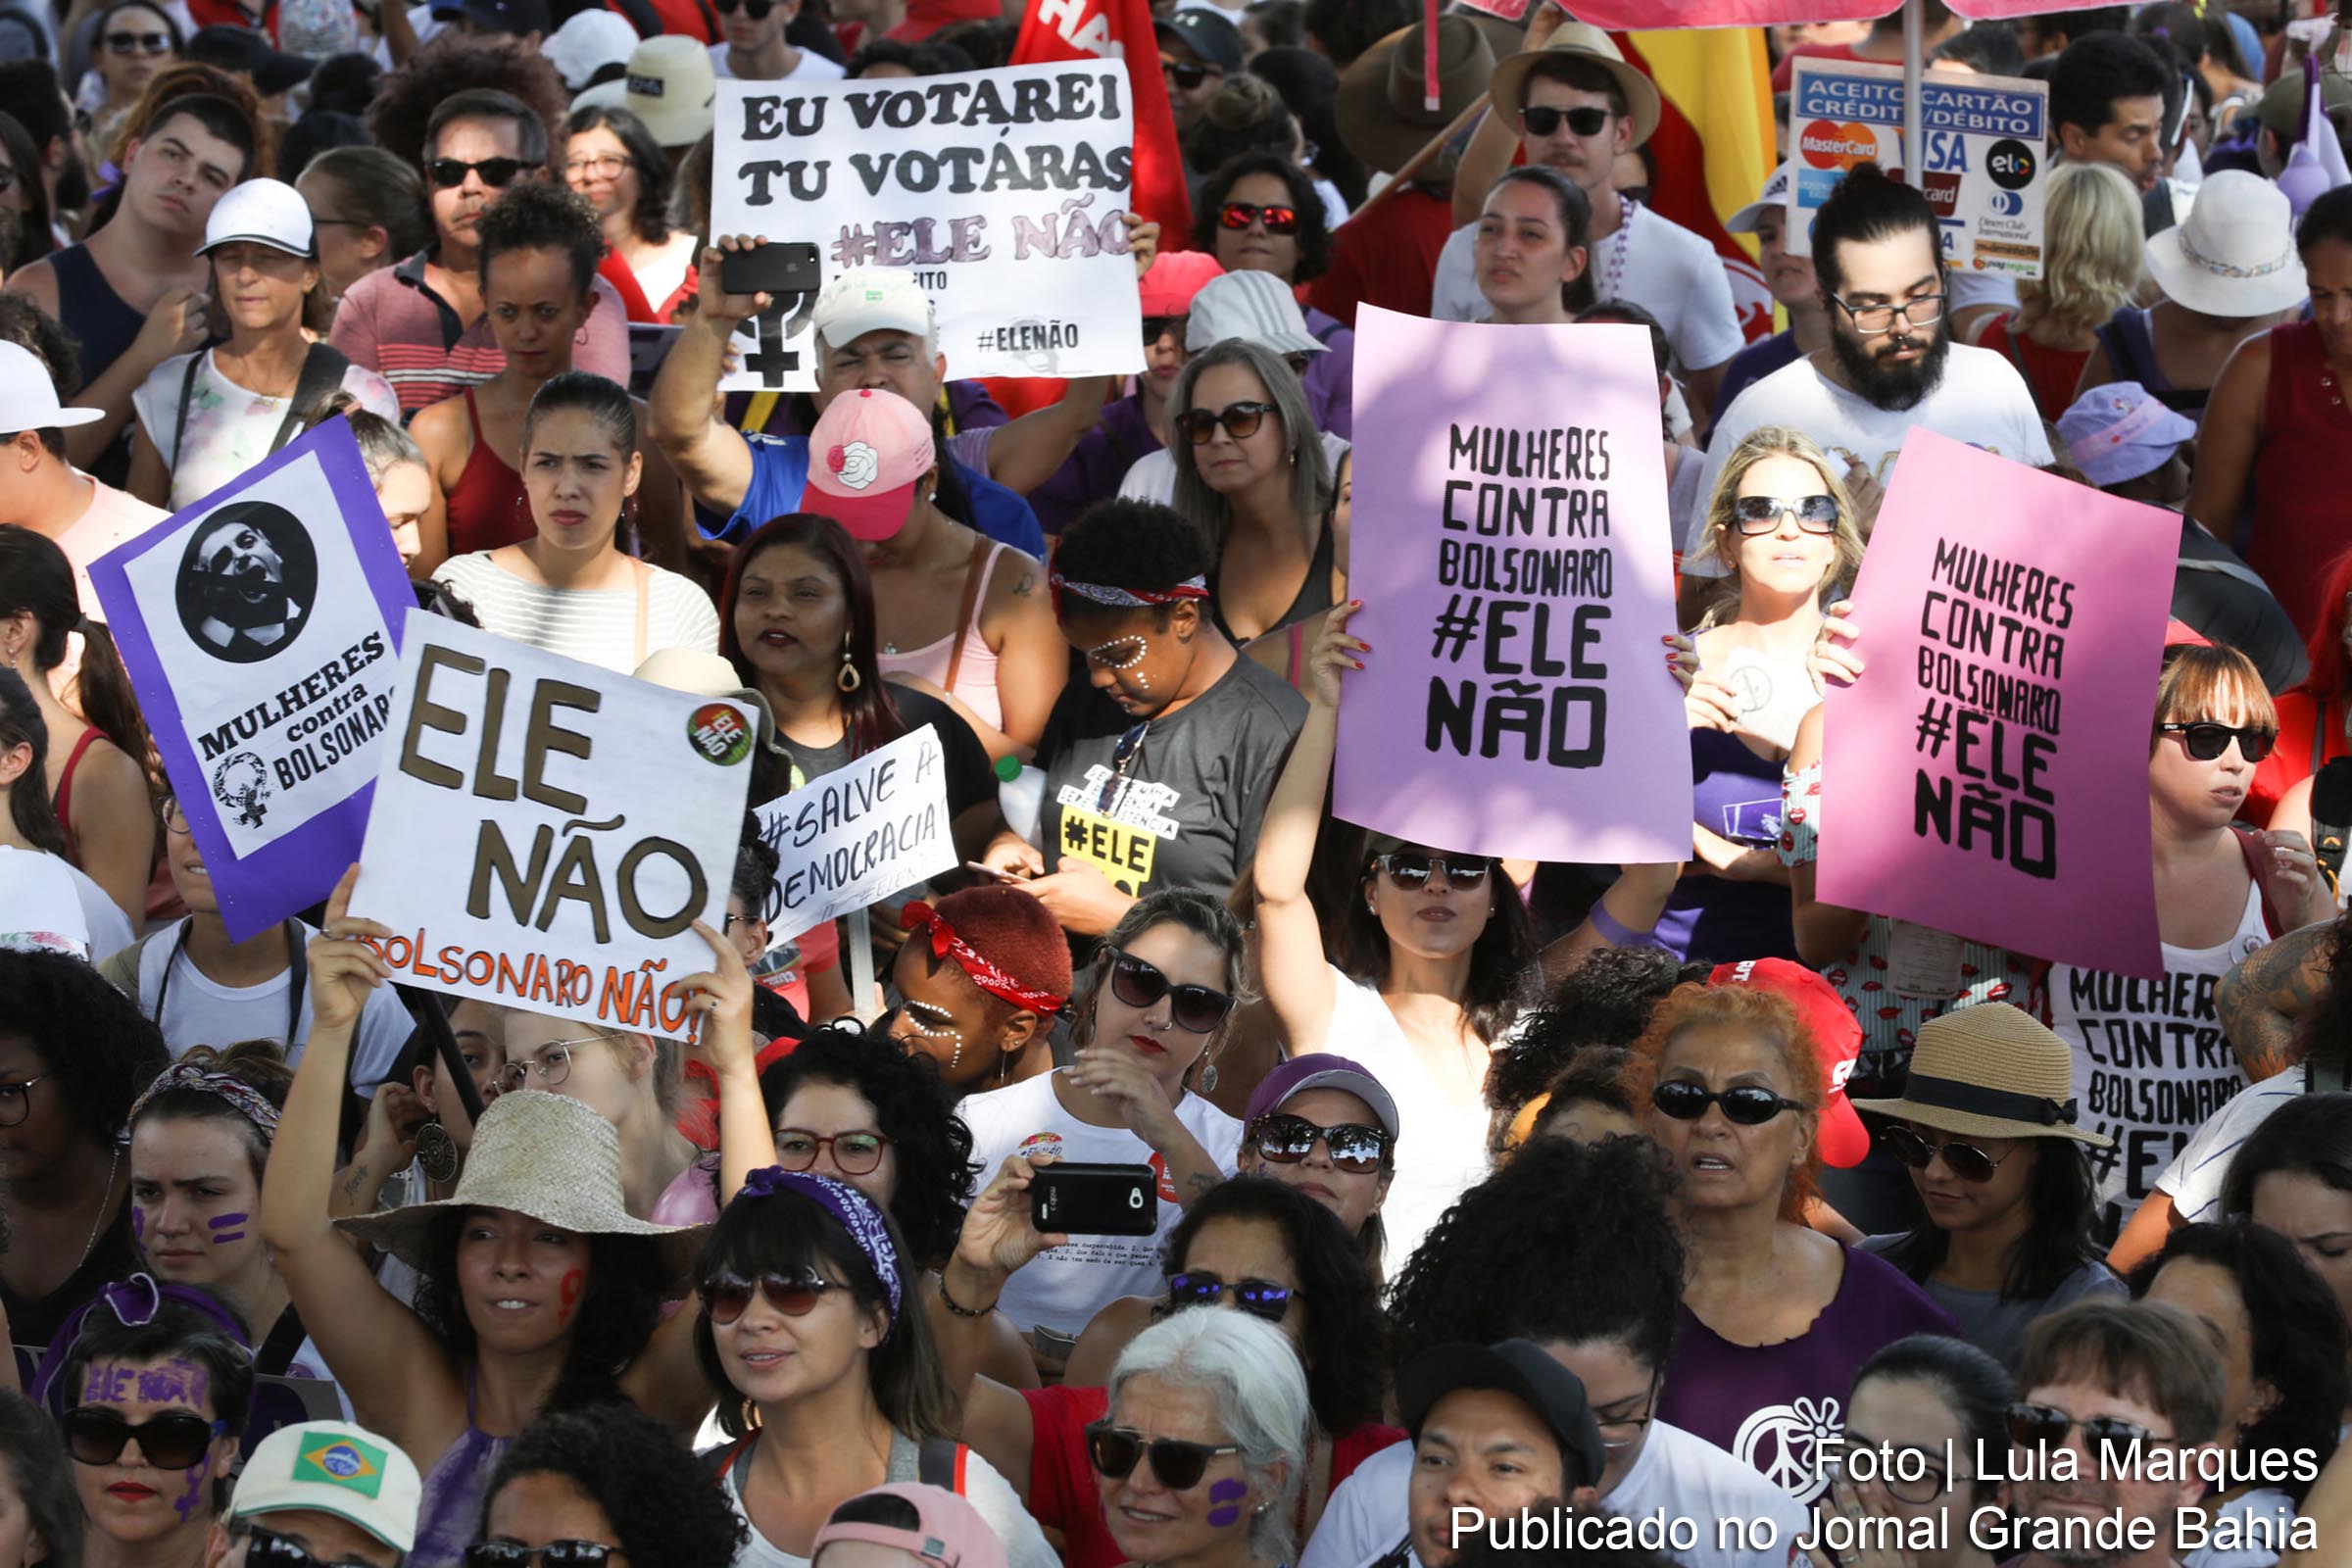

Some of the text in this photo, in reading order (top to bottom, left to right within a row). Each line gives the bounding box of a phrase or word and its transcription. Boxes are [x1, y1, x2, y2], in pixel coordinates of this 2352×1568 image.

[741, 73, 1122, 140] EU VOTAREI
[1806, 98, 2031, 134] CRÉDIT/DÉBITO
[1921, 89, 2033, 116] CARTÃO
[738, 126, 1132, 206] TU VOTÁRAS
[1801, 136, 1877, 158] MasterCard
[1991, 154, 2031, 174] elo
[831, 193, 1131, 269] #ELE NÃO
[977, 319, 1078, 352] #ELENÃO
[1448, 422, 1610, 481] MULHERES
[1444, 479, 1610, 538] CONTRA
[1439, 538, 1613, 599] BOLSONARO
[1932, 536, 2076, 630] MULHERES
[1431, 593, 1612, 679] #ELE
[1921, 590, 2065, 680] CONTRA
[197, 630, 385, 762] MULHERES
[286, 682, 368, 743] contra
[399, 643, 602, 815] ELE
[1425, 675, 1607, 768] NÃO
[1918, 645, 2061, 736] BOLSONARO
[272, 685, 395, 791] BOLSONAR
[1915, 696, 2059, 807] #ELE
[760, 741, 938, 849] #SALVE A
[1914, 767, 2057, 881] NÃO
[466, 814, 709, 945] NÃO
[1064, 814, 1150, 874] #ELE
